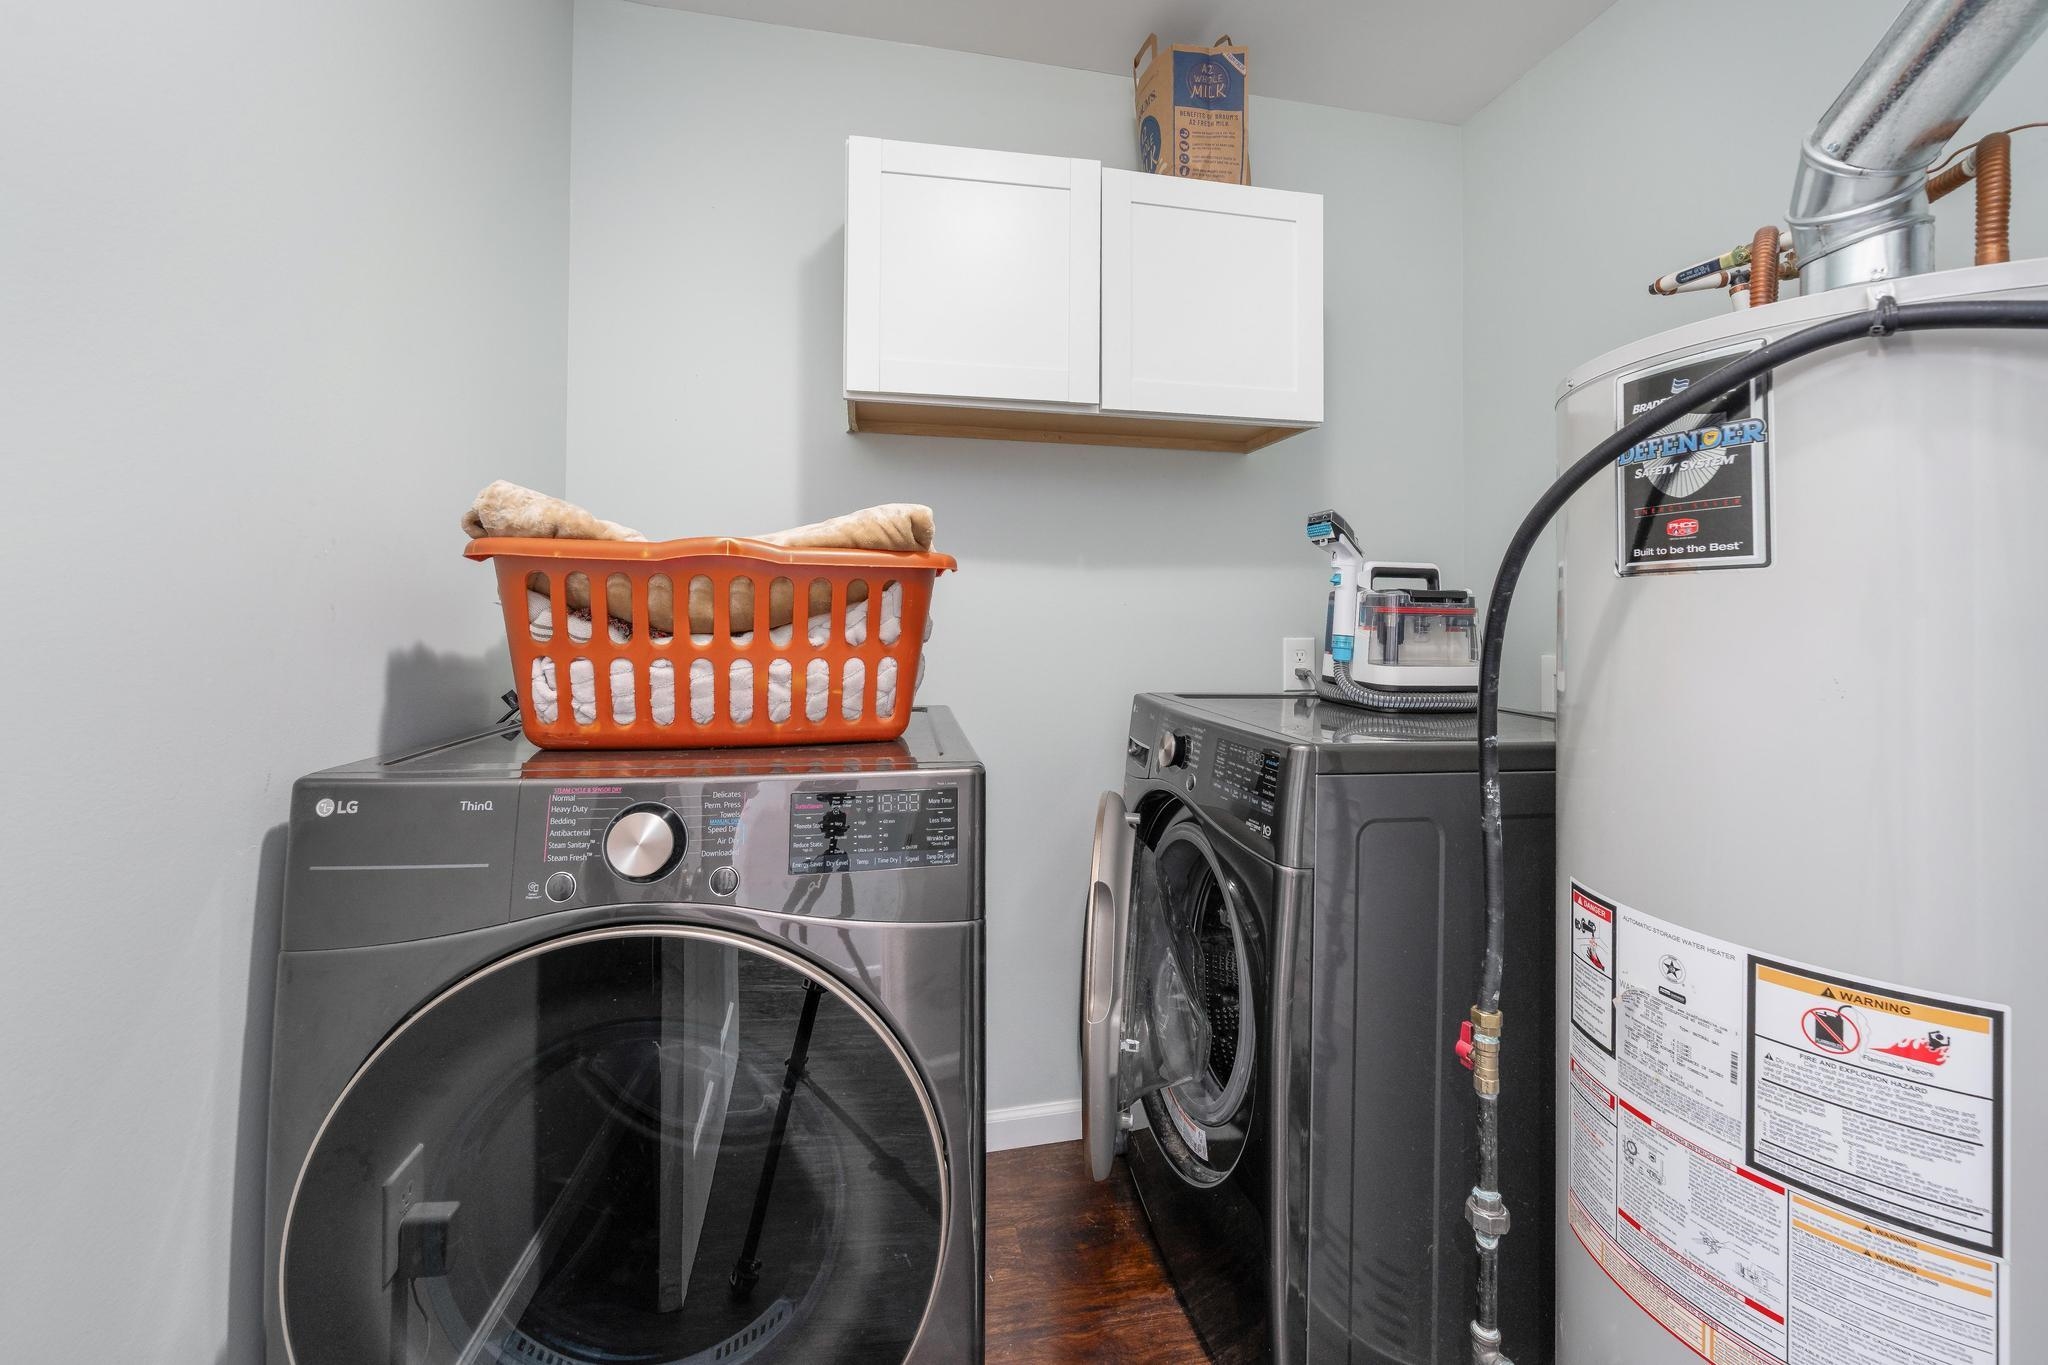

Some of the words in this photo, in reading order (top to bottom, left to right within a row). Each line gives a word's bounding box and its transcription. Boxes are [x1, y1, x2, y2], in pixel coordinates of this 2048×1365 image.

[1190, 83, 1227, 99] MILK
[1618, 418, 1767, 466] DEFENDER
[1634, 463, 1679, 479] SAFETY
[1633, 547, 1655, 557] Built
[1656, 547, 1668, 555] to
[1669, 545, 1684, 554] be
[1687, 544, 1707, 553] the
[712, 791, 741, 799] Delicates
[336, 800, 359, 814] LG
[460, 800, 494, 811] ThinQ
[551, 805, 572, 814] Heavy
[572, 805, 588, 814] Duty
[550, 818, 577, 826] Bedding
[549, 829, 591, 837] Antibacterial
[707, 826, 728, 834] Speed
[548, 841, 566, 849] Steam
[547, 854, 568, 862] Steam
[1583, 900, 1606, 918] DANGER
[1622, 915, 1652, 932] AUTOMATIC
[1652, 927, 1681, 943] STORAGE
[1681, 938, 1706, 951] WATER
[1706, 946, 1737, 961] HEATER
[1839, 990, 1911, 1016] WARNING
[1863, 1054, 1904, 1070] Flammable
[1905, 1064, 1935, 1078] Vapors
[1799, 1052, 1816, 1063] FIRE
[1819, 1059, 1836, 1069] AND
[1839, 1065, 1887, 1084] EXPLOSION
[1890, 1079, 1927, 1095] HAZARD
[1875, 1254, 1918, 1273] WARNING
